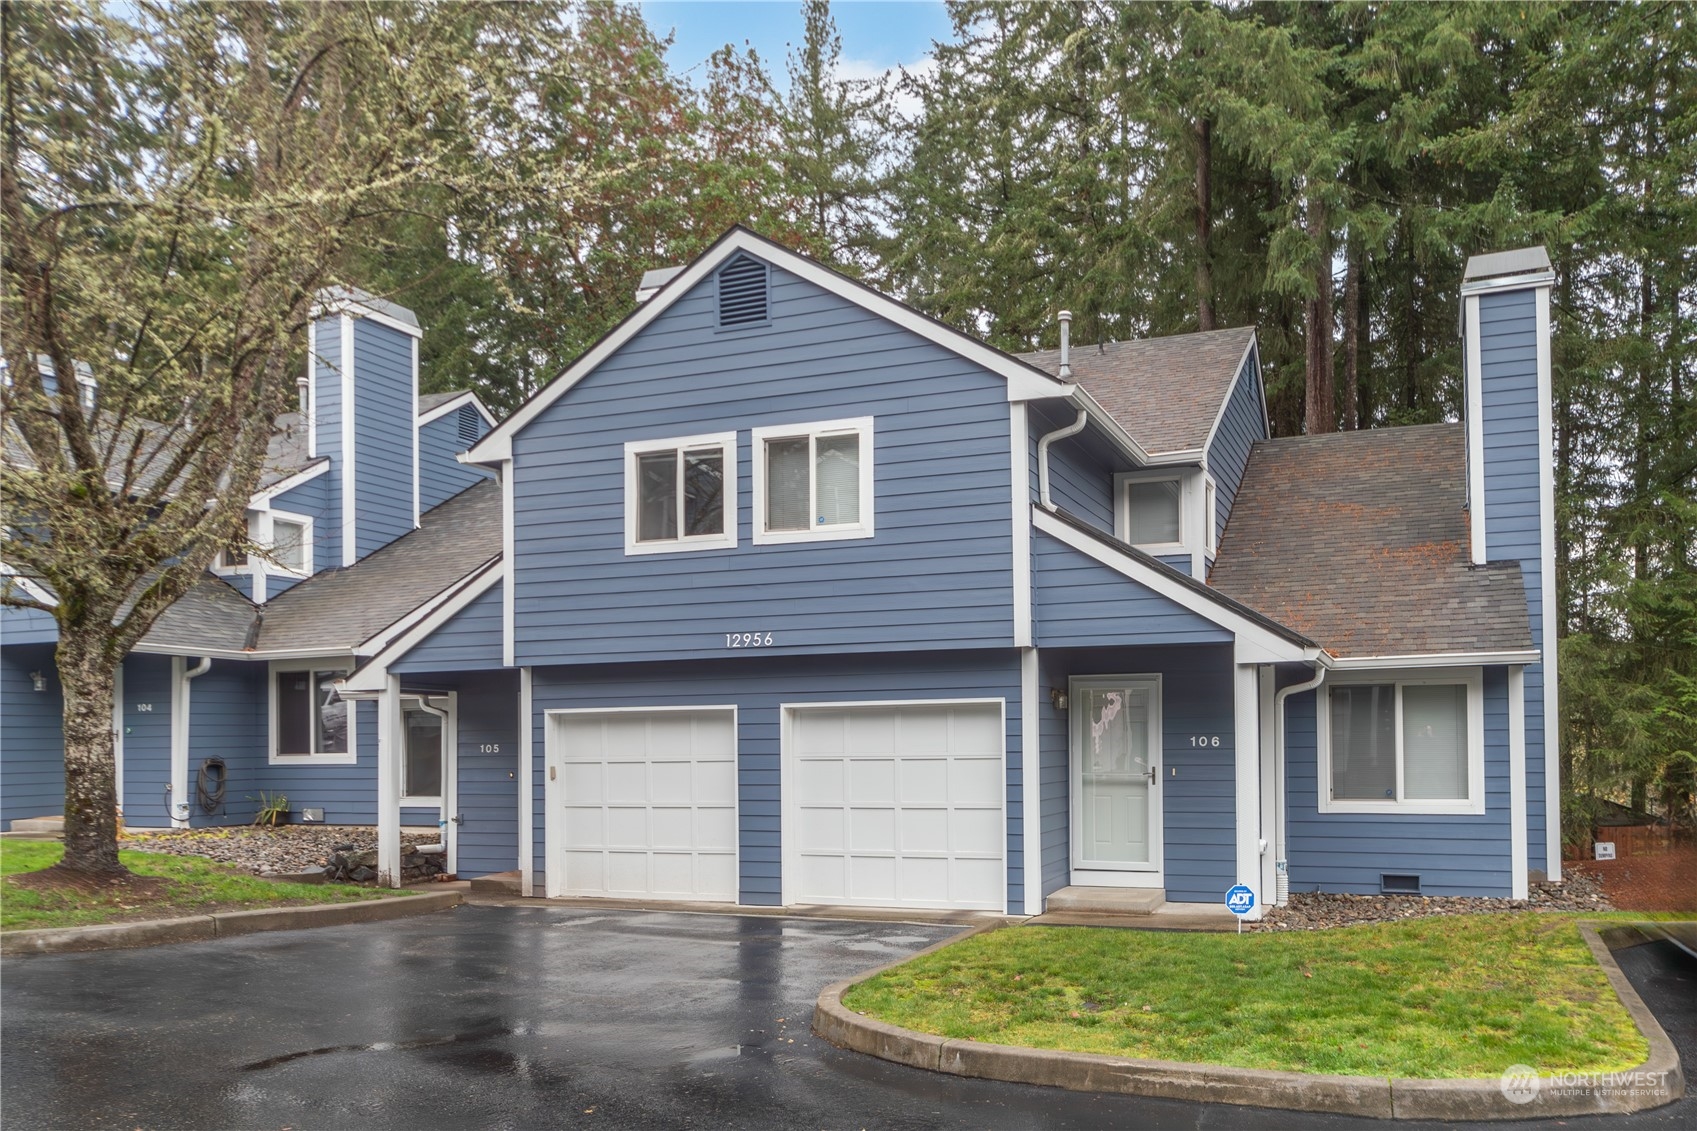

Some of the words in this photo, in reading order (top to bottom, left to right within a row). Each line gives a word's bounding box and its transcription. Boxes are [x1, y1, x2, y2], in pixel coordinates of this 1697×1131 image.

[726, 632, 773, 647] 12956
[1190, 736, 1220, 747] 106
[480, 743, 500, 753] 105
[1228, 893, 1252, 904] ADT
